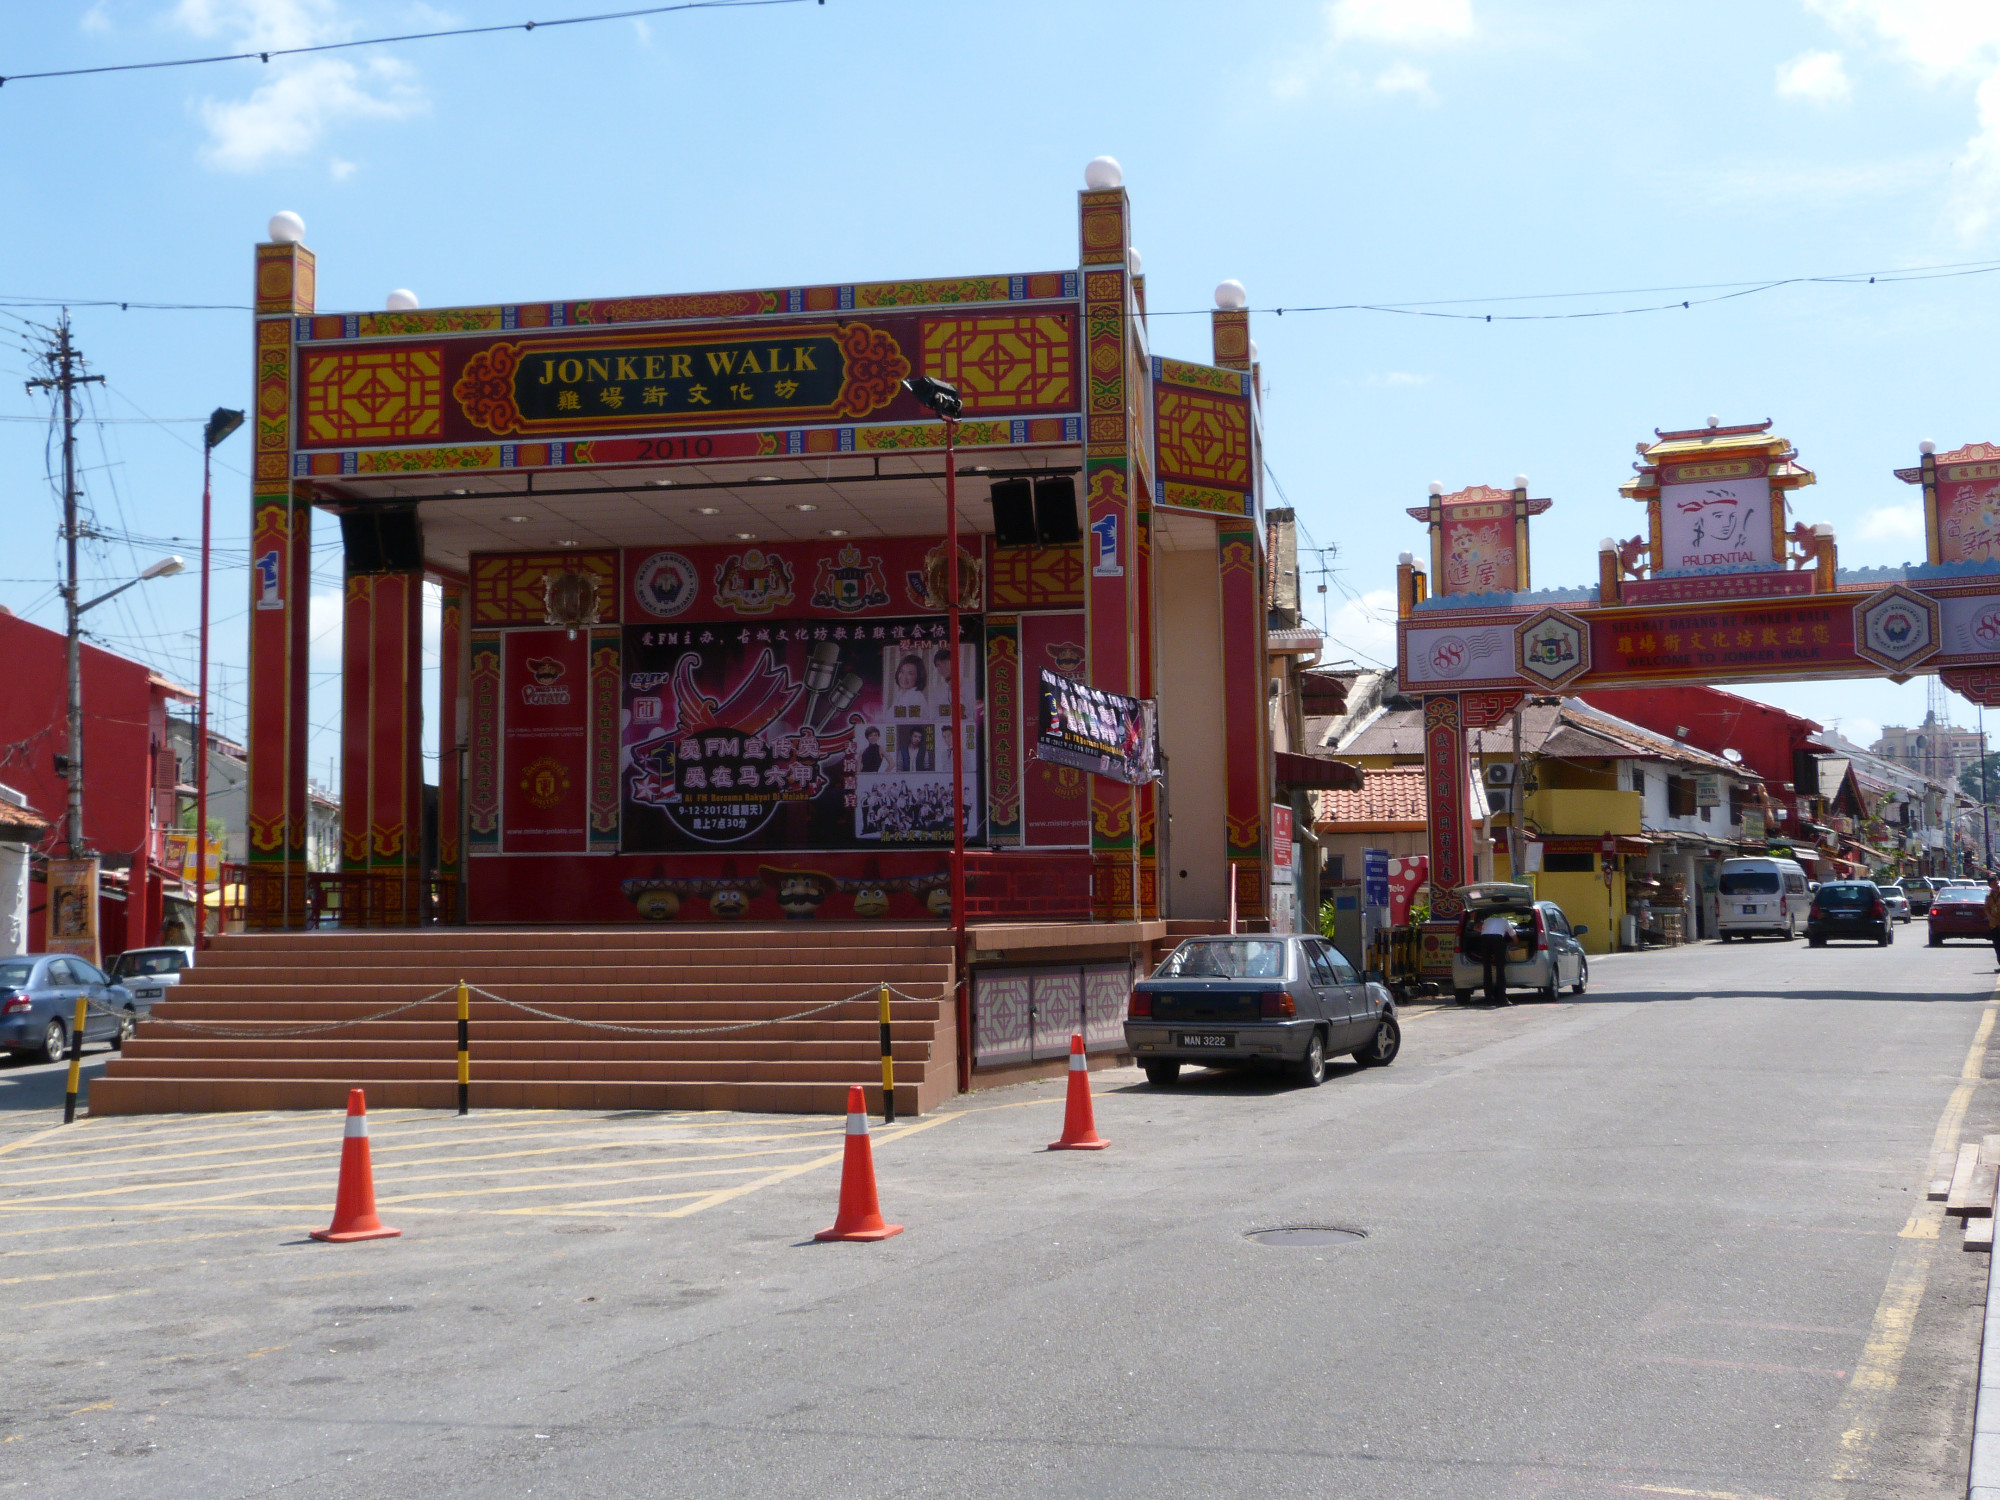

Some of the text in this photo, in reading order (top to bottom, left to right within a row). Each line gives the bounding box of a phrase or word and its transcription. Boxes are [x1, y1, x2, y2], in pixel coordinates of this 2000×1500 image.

[539, 346, 818, 385] JONKER WALK
[556, 379, 800, 411] 雞場街文化坊
[638, 437, 713, 460] 2010
[1682, 551, 1757, 567] PRUDENTIAL
[1612, 609, 1832, 634] SELAMAT DATANG KE JONKER WALK
[1626, 646, 1821, 668] WELCOME TO JONKER WALK
[683, 763, 814, 789] 爱在马六甲
[1203, 1036, 1226, 1046] 3222
